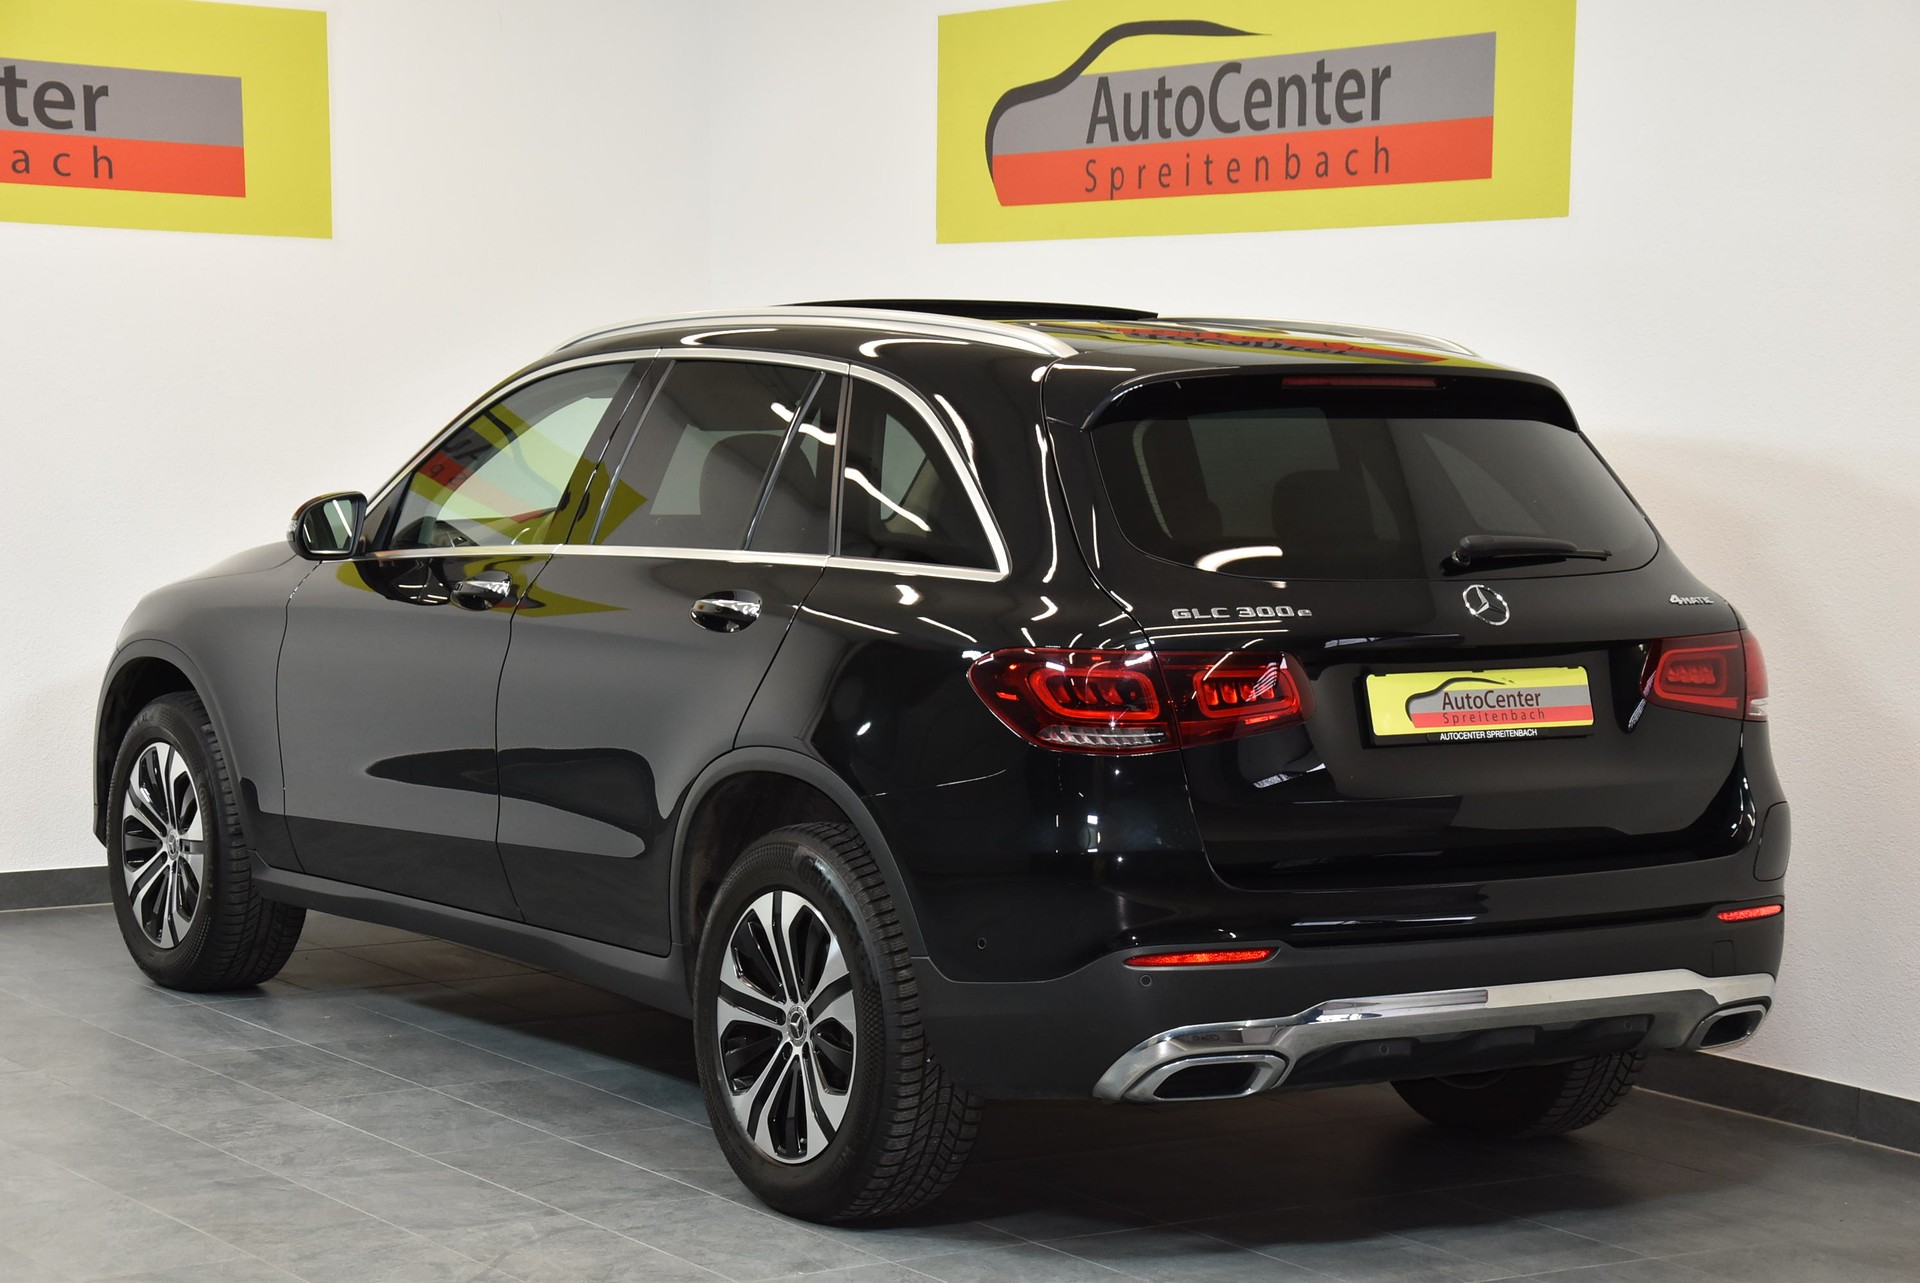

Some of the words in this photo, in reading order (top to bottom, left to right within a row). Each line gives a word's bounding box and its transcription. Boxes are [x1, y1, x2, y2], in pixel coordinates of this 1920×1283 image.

[1085, 58, 1392, 145] AutoCenter
[1084, 136, 1391, 201] Spreitenbach
[1171, 606, 1231, 620] GLC
[1442, 689, 1541, 711] AutoCenter
[1442, 708, 1545, 726] Spreitenbach
[1439, 731, 1486, 741] AUTOCENTER
[1486, 728, 1538, 739] SPREITENBACH
